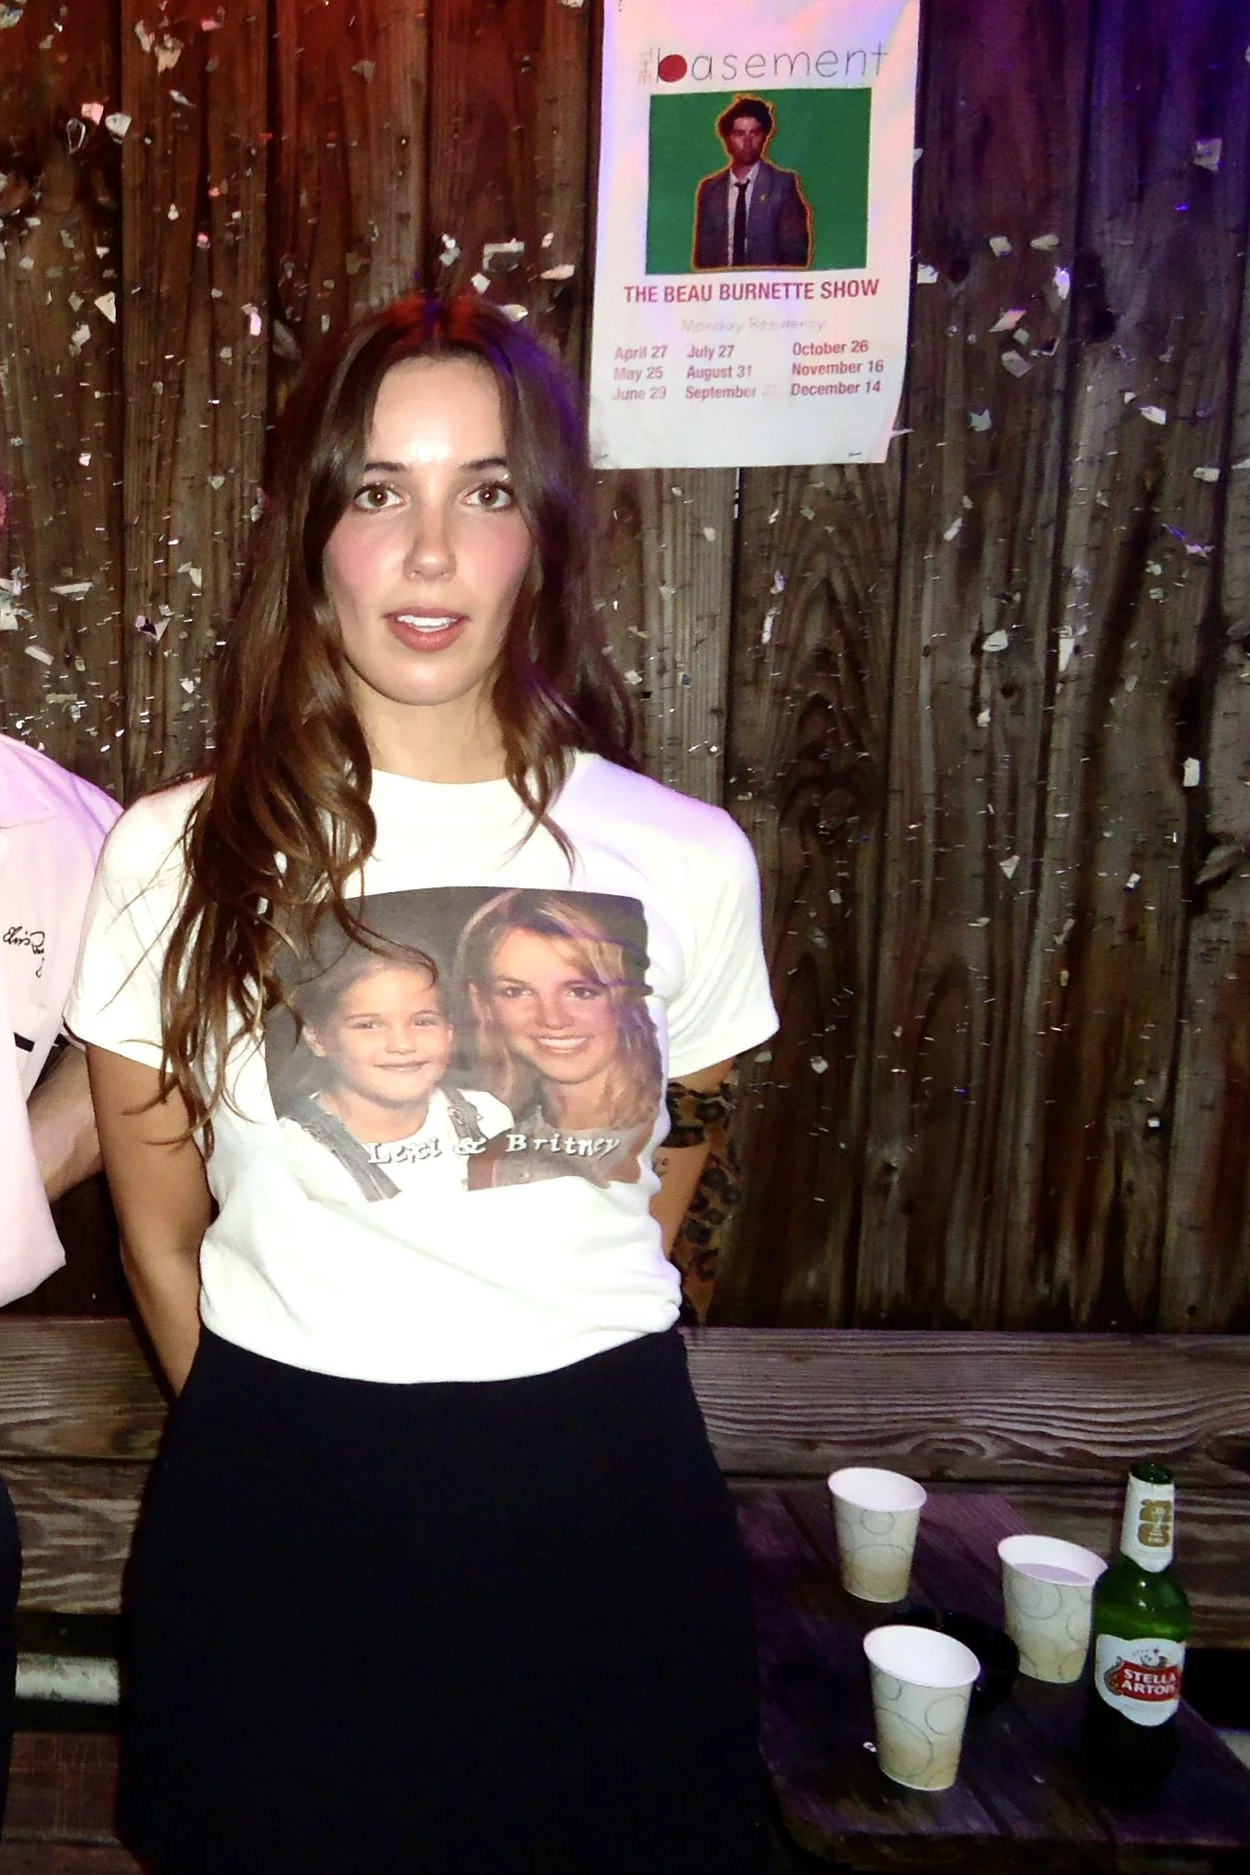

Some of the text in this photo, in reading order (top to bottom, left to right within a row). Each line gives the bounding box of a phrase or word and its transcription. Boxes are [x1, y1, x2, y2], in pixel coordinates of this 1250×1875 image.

[656, 42, 889, 84] basement
[624, 279, 880, 304] THE BEAU BURNETTE SHOW
[681, 319, 744, 334] Monday
[614, 345, 668, 361] April 27
[687, 345, 735, 361] July 27
[792, 340, 869, 356] October 26
[613, 366, 664, 382] May 25
[686, 365, 753, 381] August 31
[792, 360, 884, 376] November 16
[612, 388, 646, 401] June
[685, 385, 757, 402] September
[790, 382, 862, 397] December
[865, 380, 881, 393] 14
[367, 1134, 621, 1165] Lexi & Britney
[1123, 1668, 1177, 1684] STELLA
